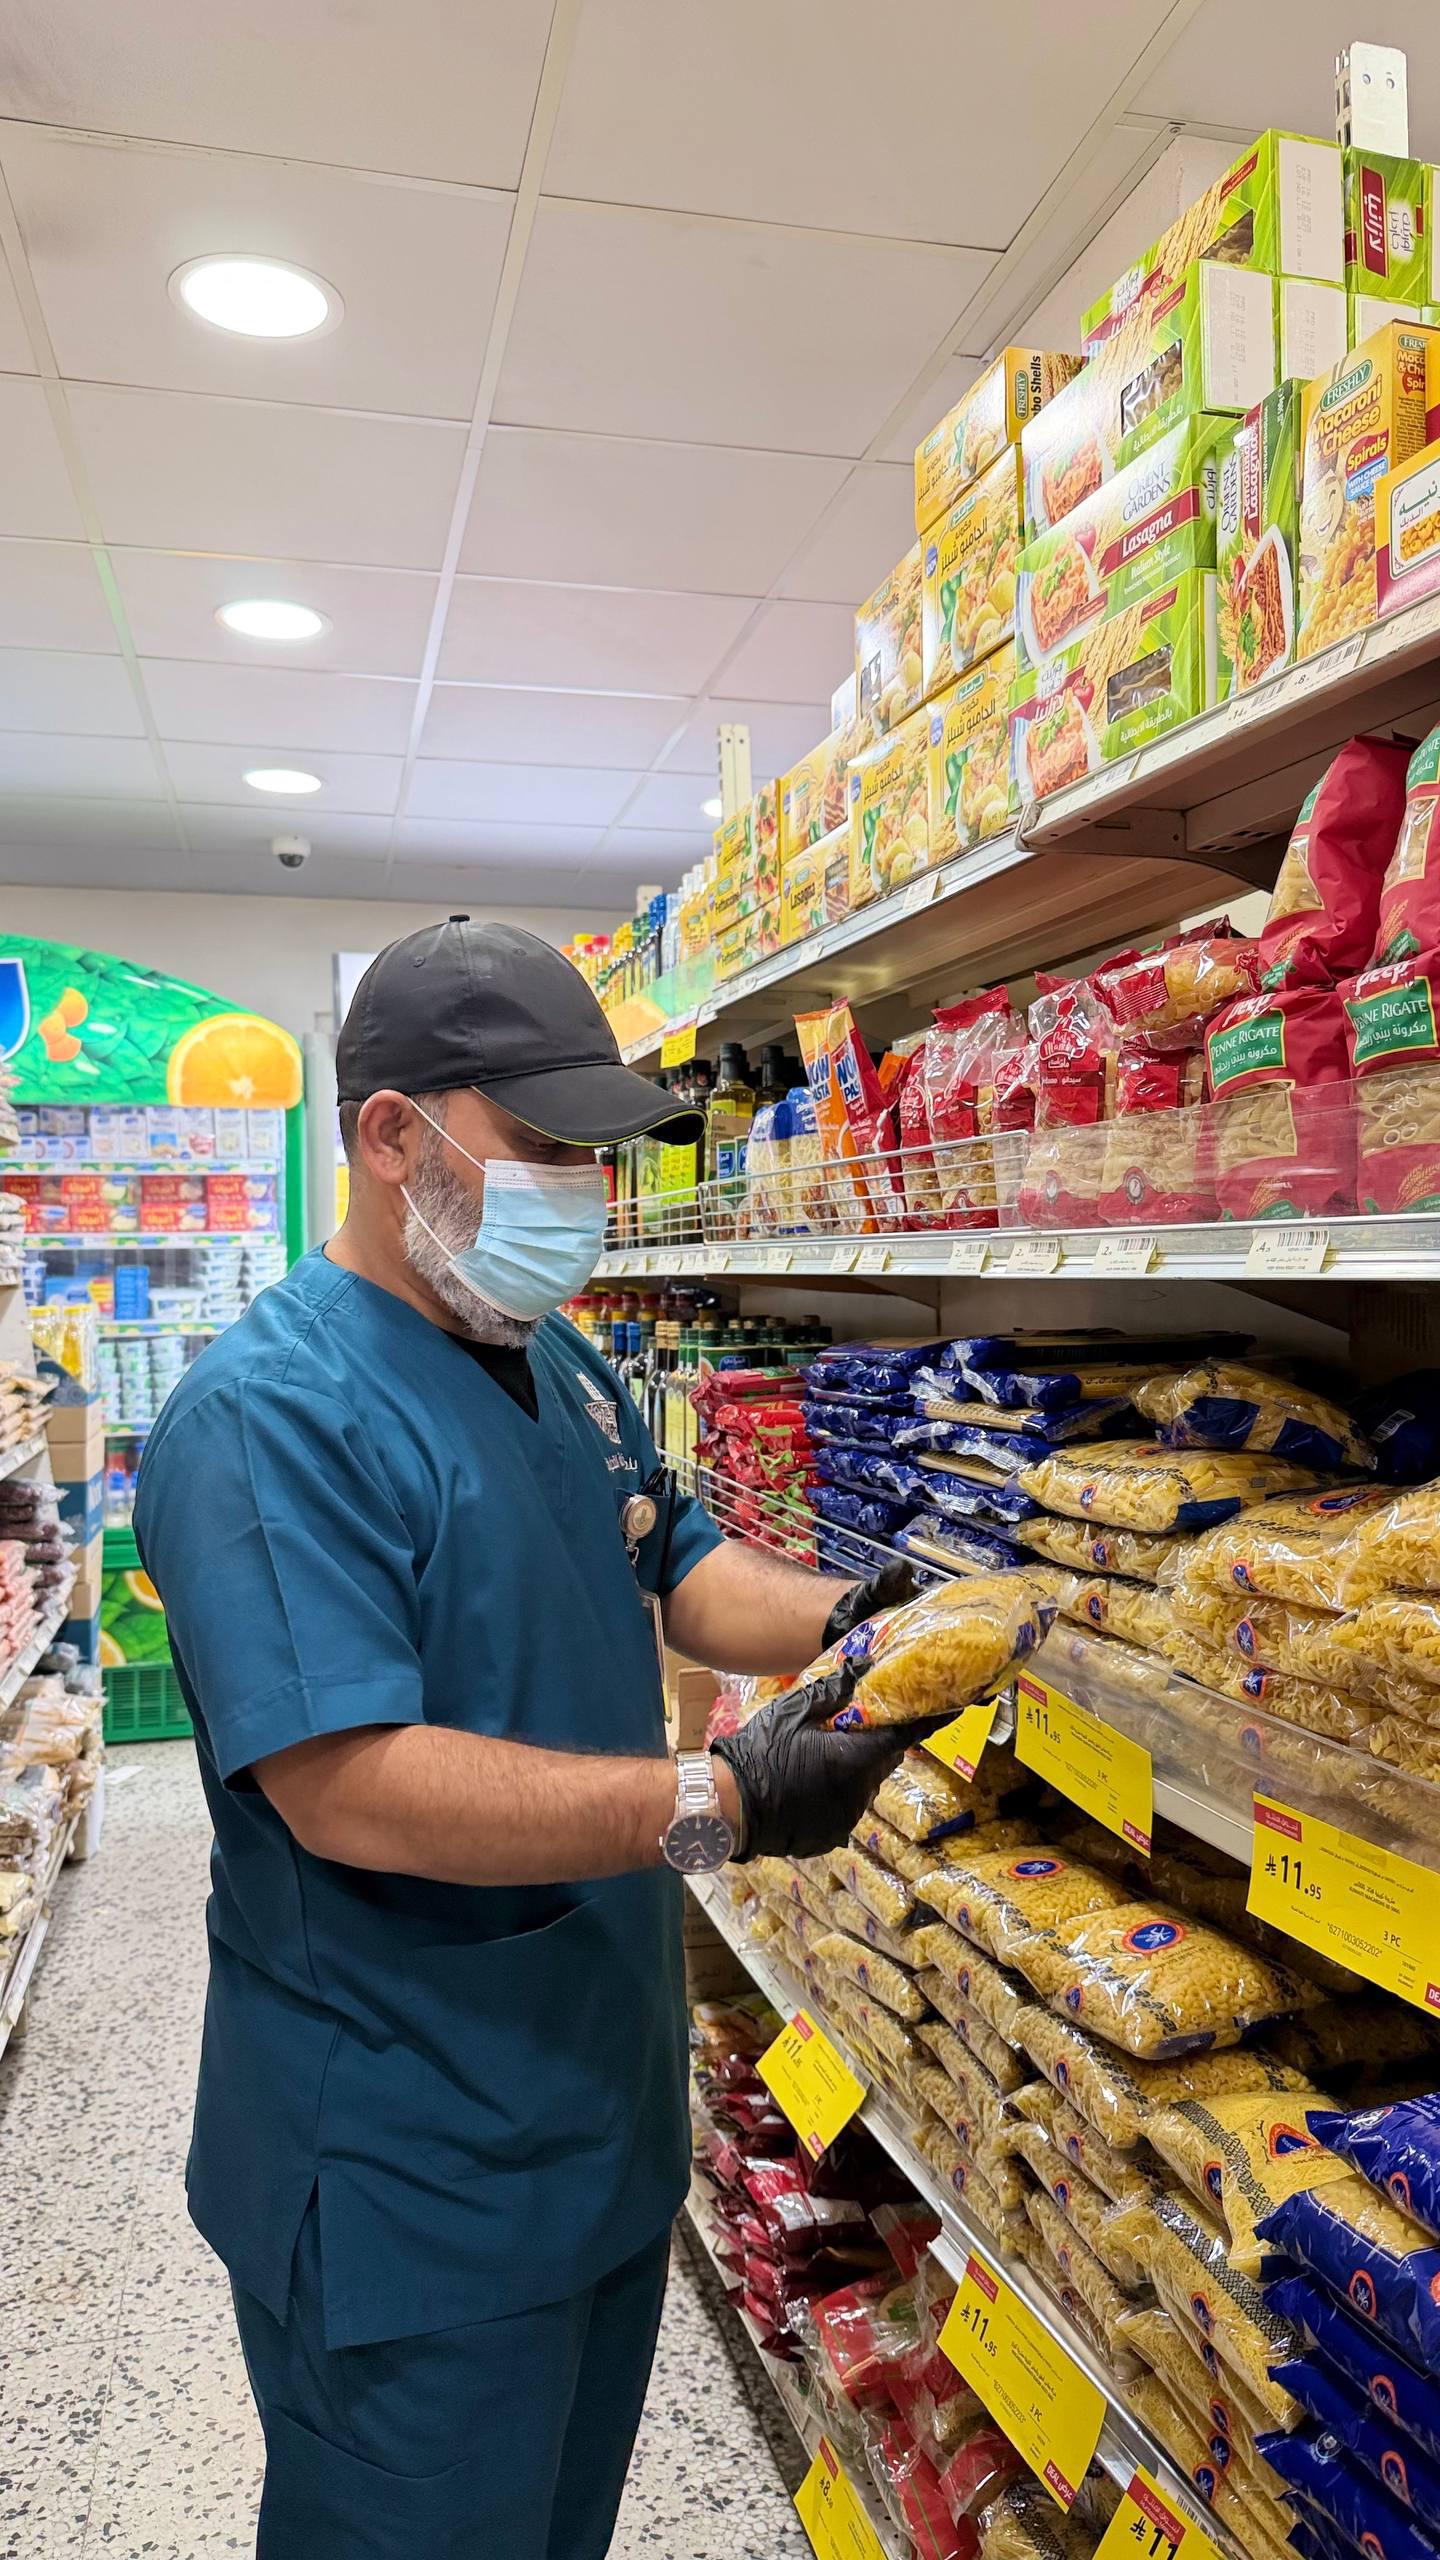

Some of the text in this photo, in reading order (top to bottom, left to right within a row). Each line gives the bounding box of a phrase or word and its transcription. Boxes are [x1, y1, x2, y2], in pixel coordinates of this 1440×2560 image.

[1365, 193, 1384, 254] لازانيا
[1031, 355, 1042, 393] Shells
[1325, 366, 1368, 405] FRESHLY
[1312, 374, 1383, 441] Macaroni
[1323, 405, 1381, 457] Cheese
[1347, 436, 1387, 471] Spirals
[1122, 478, 1172, 521] GARDENS
[1121, 509, 1174, 559] Lasagna
[1381, 999, 1429, 1020] RIGATE
[1211, 1026, 1280, 1061] PENNE RIGATE
[1383, 1930, 1401, 1948] 3 PC
[1046, 2464, 1059, 2483] DEAL
